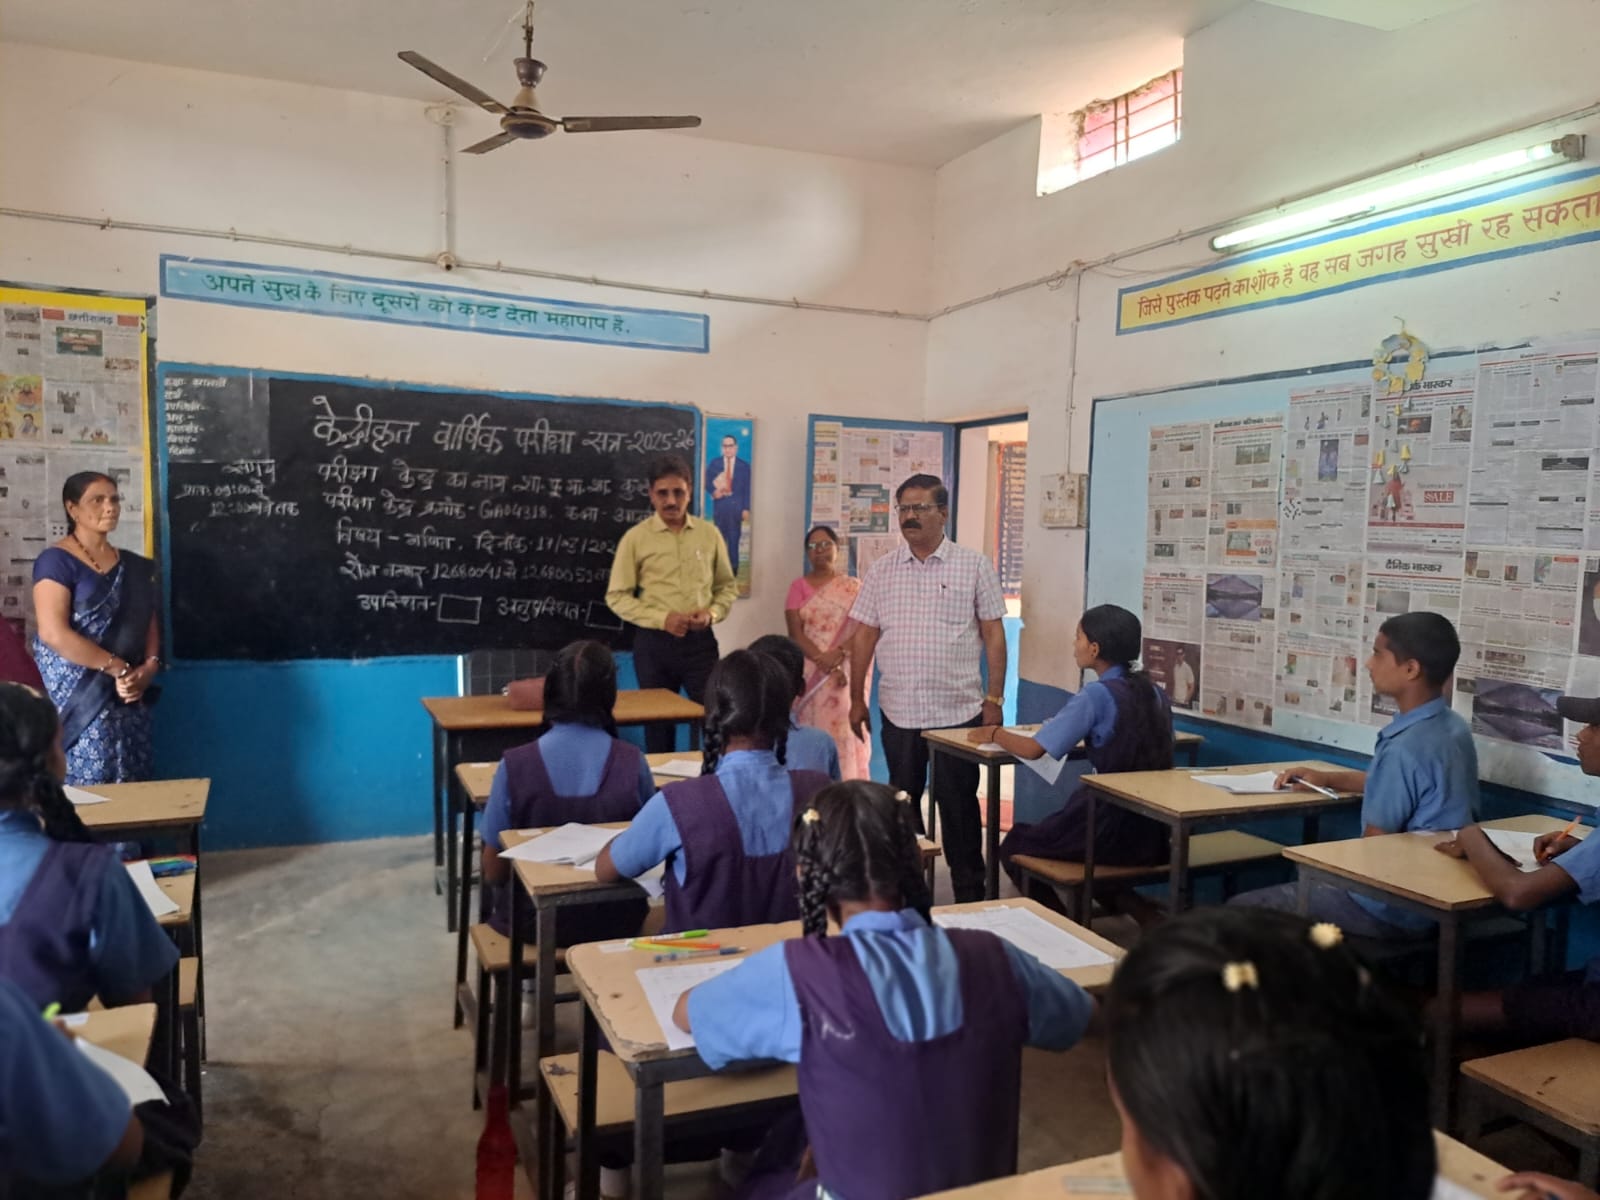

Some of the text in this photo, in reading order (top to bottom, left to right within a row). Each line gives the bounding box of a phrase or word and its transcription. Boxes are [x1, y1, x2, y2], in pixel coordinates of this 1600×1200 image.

[1138, 296, 1162, 318] जिसे
[1166, 289, 1201, 315] पुस्तक
[1203, 278, 1231, 303] पढ़ने
[1282, 262, 1294, 289] है
[1299, 261, 1320, 284] वह
[1324, 253, 1351, 276] सब
[1356, 239, 1408, 268] जगह
[1415, 219, 1473, 259] सुखी
[1481, 212, 1514, 240] रह
[202, 273, 256, 294] अपने
[262, 280, 301, 302] सुख
[304, 280, 322, 301] के
[427, 295, 453, 315] को
[457, 301, 501, 320] कष्ट
[504, 303, 538, 326] देता
[543, 311, 608, 332] महापाप
[1423, 379, 1453, 390] भास्कर
[433, 412, 507, 454] वार्षिक
[513, 417, 577, 455] परीक्षा
[317, 454, 379, 483] परीक्षा
[446, 471, 468, 489] का
[471, 474, 508, 493] नाम
[322, 485, 376, 512] परीक्षा
[1424, 491, 1454, 503] SALE
[336, 516, 382, 549] विषय
[1385, 559, 1442, 573] दैनिक भास्कर
